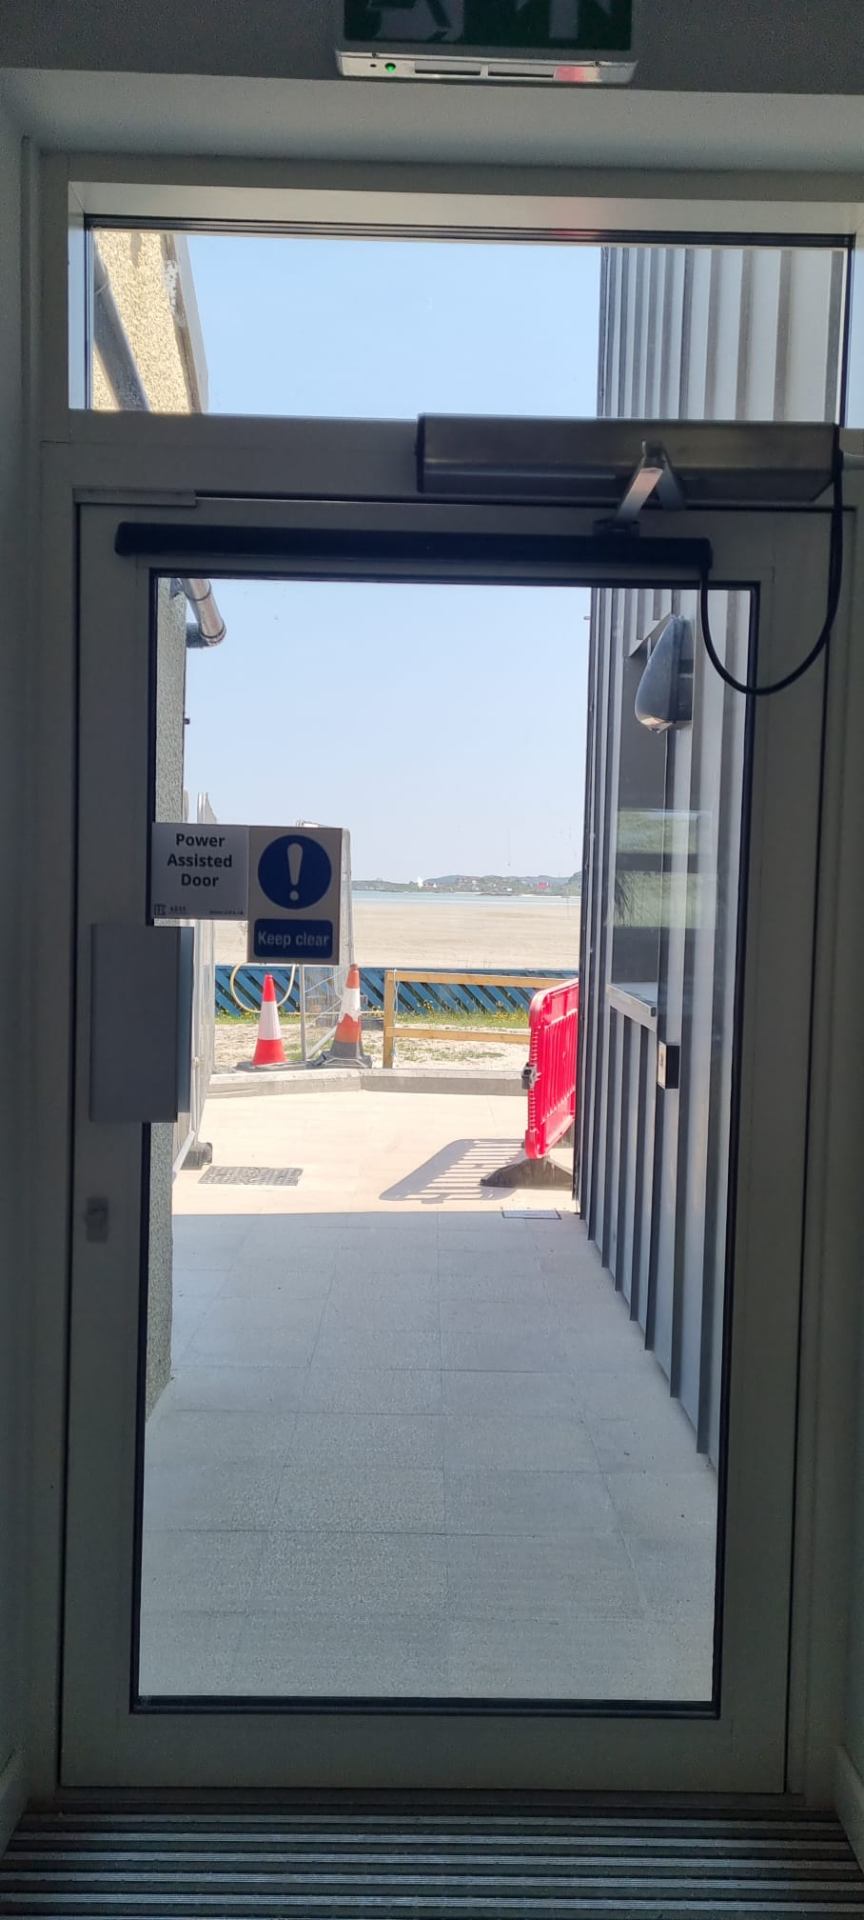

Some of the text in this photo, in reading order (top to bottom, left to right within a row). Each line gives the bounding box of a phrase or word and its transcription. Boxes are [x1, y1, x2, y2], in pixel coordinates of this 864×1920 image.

[176, 833, 225, 847] Power
[167, 853, 233, 868] Assisted
[181, 873, 219, 887] Door
[257, 930, 330, 948] Keep clear
